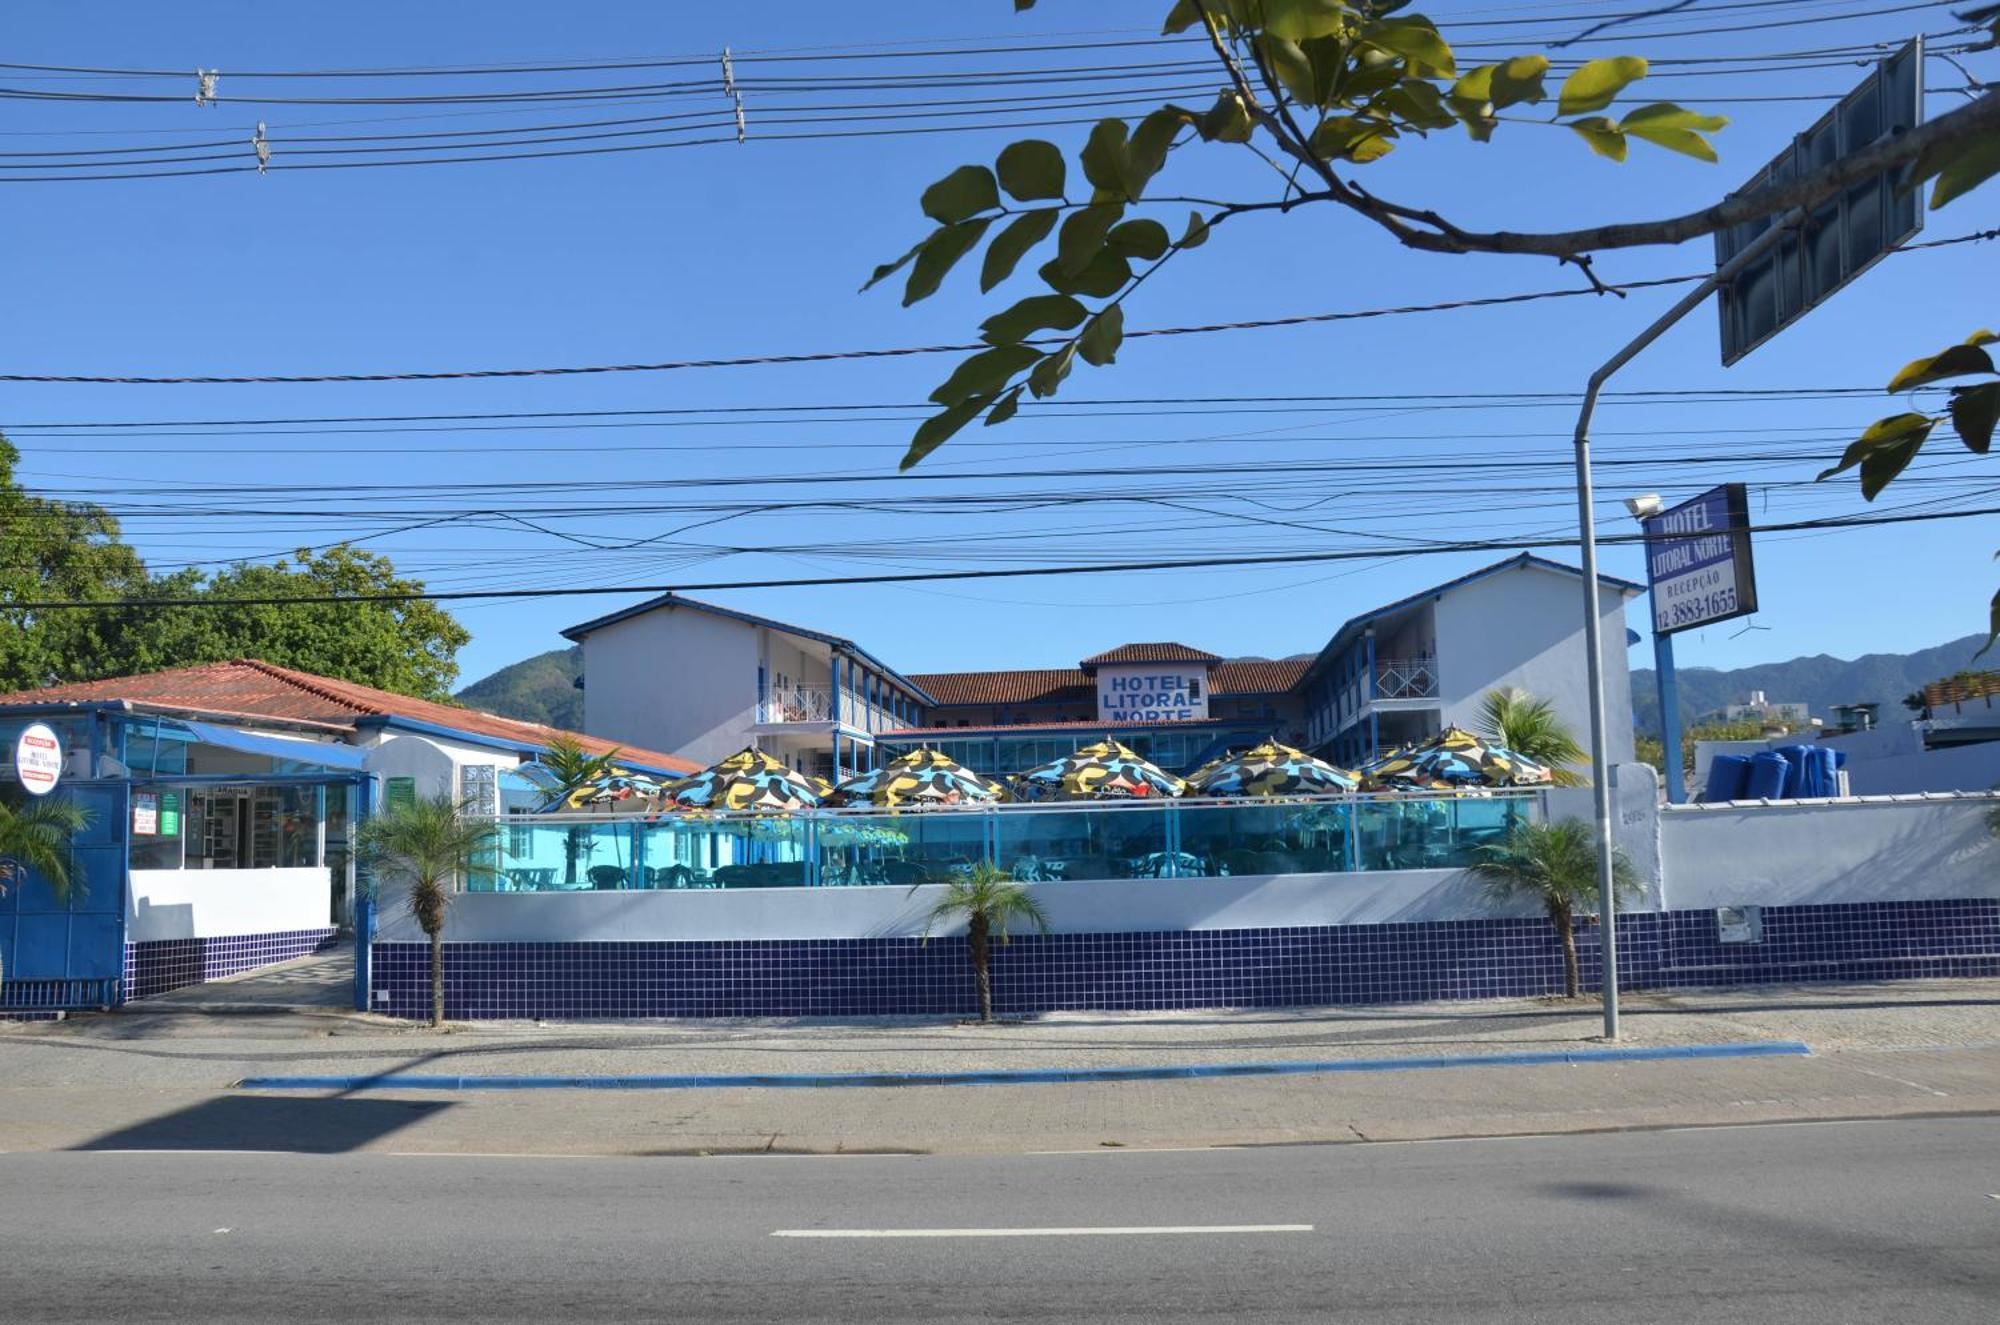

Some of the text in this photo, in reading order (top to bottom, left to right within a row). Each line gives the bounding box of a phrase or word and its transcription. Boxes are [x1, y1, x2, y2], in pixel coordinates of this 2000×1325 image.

[1662, 502, 1713, 544] HOTEL
[1651, 533, 1732, 578] LITORAL NORTE
[1667, 569, 1720, 599] RECEPÇÃO
[1112, 675, 1190, 691] HOTEL
[1103, 693, 1202, 708] LITORAL
[1112, 709, 1192, 721] NORTE
